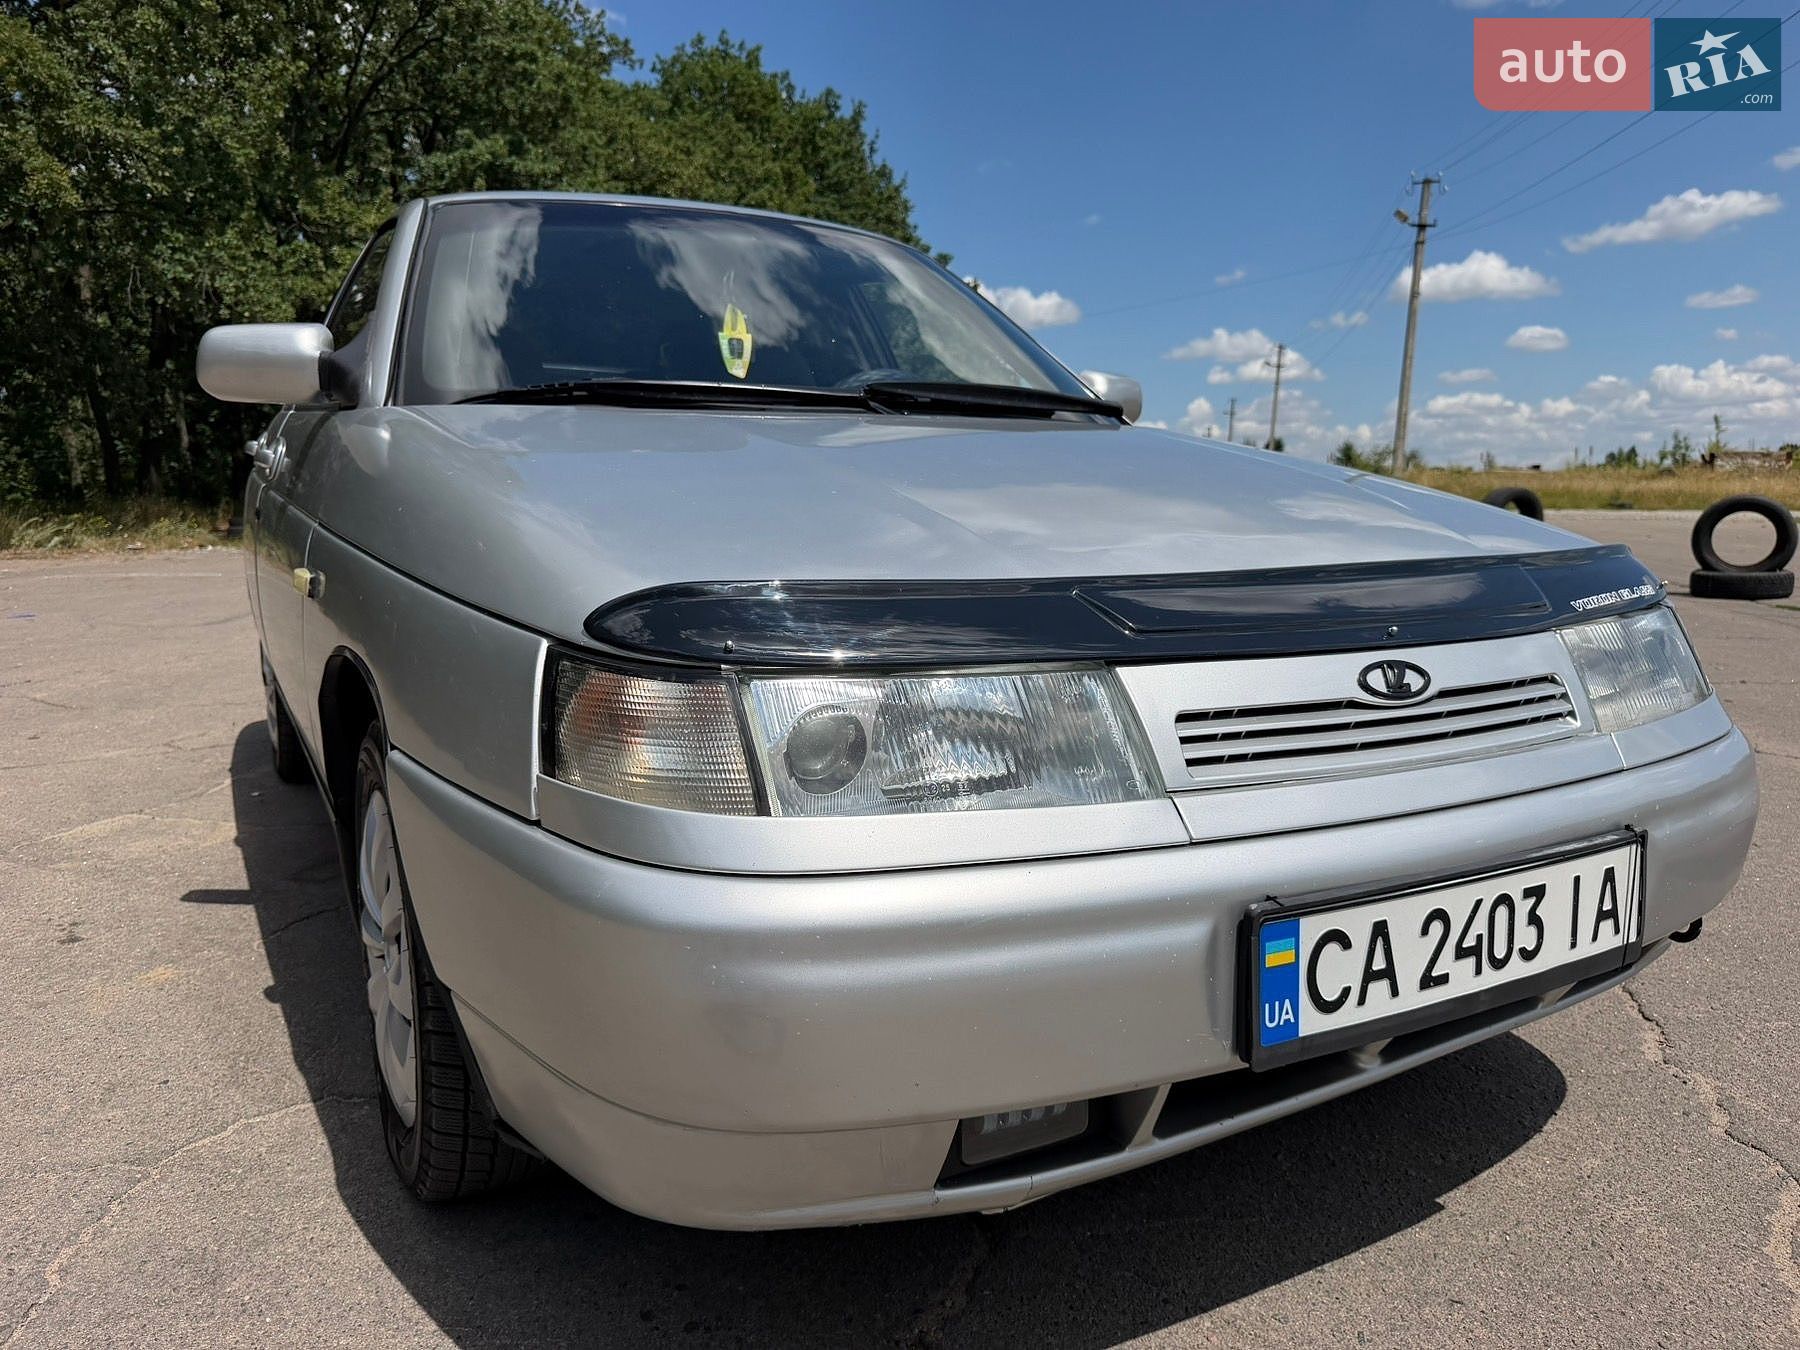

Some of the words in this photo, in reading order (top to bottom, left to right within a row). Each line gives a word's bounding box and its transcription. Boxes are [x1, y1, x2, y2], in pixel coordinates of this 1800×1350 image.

[1306, 919, 1400, 1014] CA
[1419, 883, 1547, 992] 2403
[1569, 866, 1621, 949] IA
[1265, 998, 1295, 1028] UA
